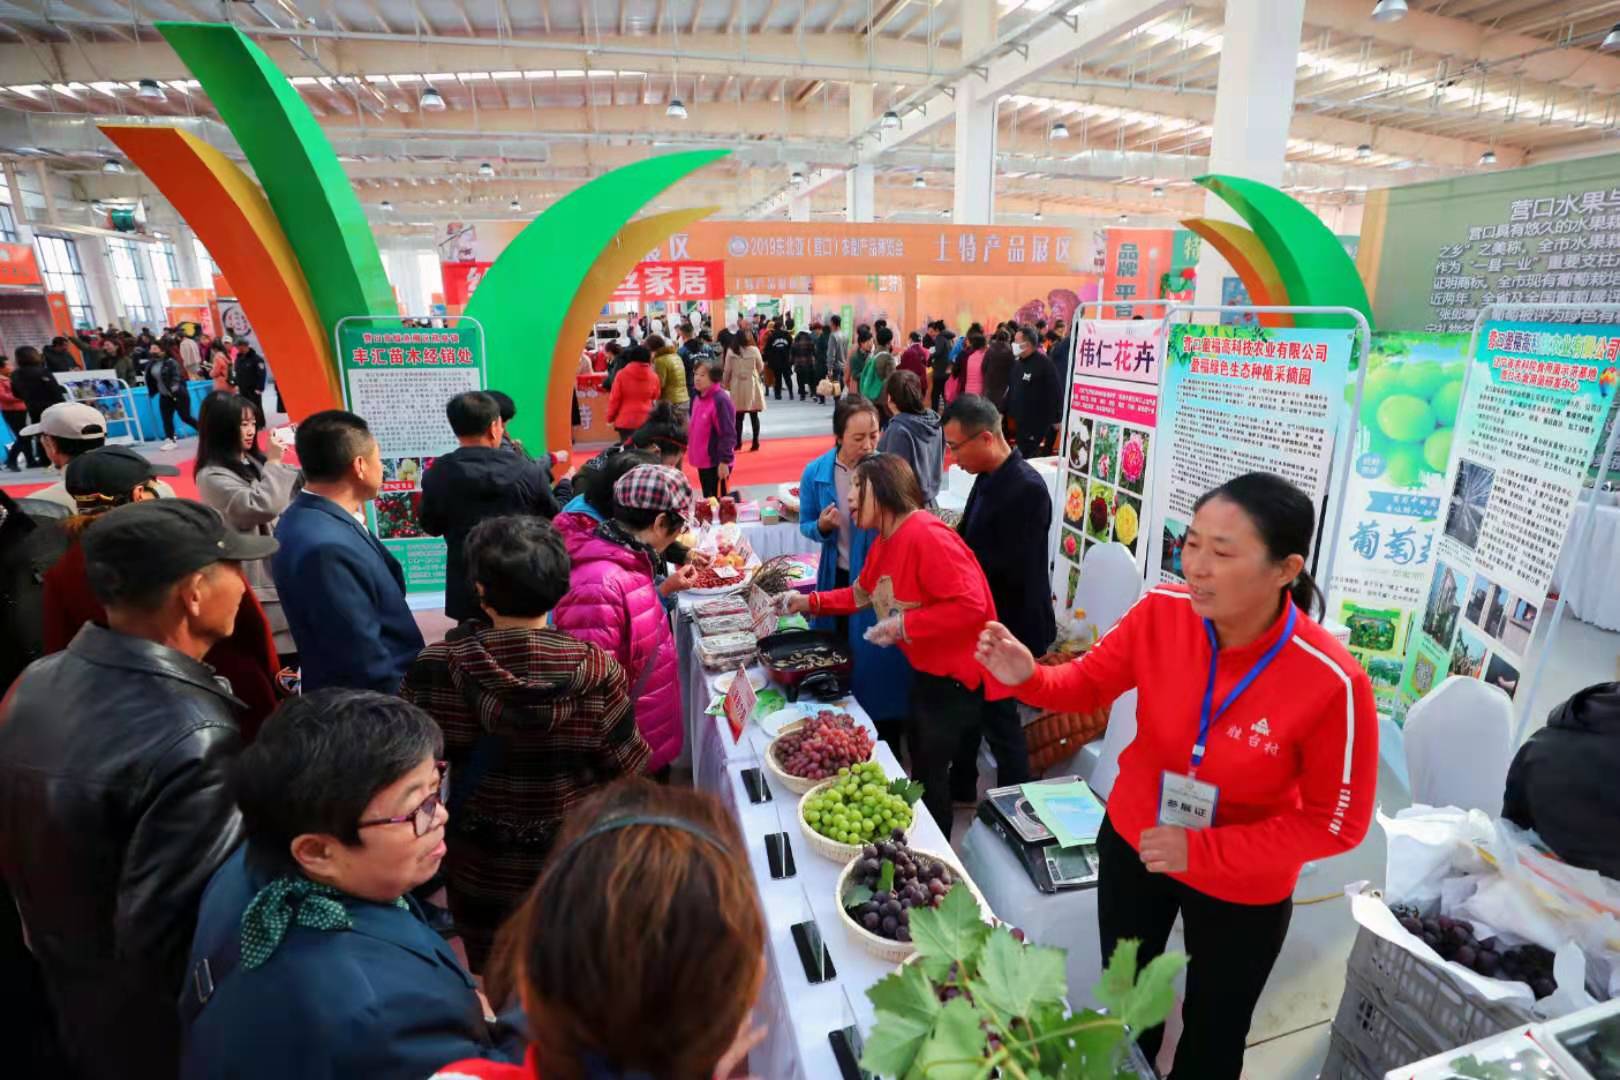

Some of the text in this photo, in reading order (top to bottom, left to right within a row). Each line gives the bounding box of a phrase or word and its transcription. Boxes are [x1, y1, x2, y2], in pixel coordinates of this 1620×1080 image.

[936, 234, 1072, 263] 土特产品展区
[352, 347, 473, 365] 丰汇苗木经销处
[1080, 338, 1155, 373] 伟仁花卉
